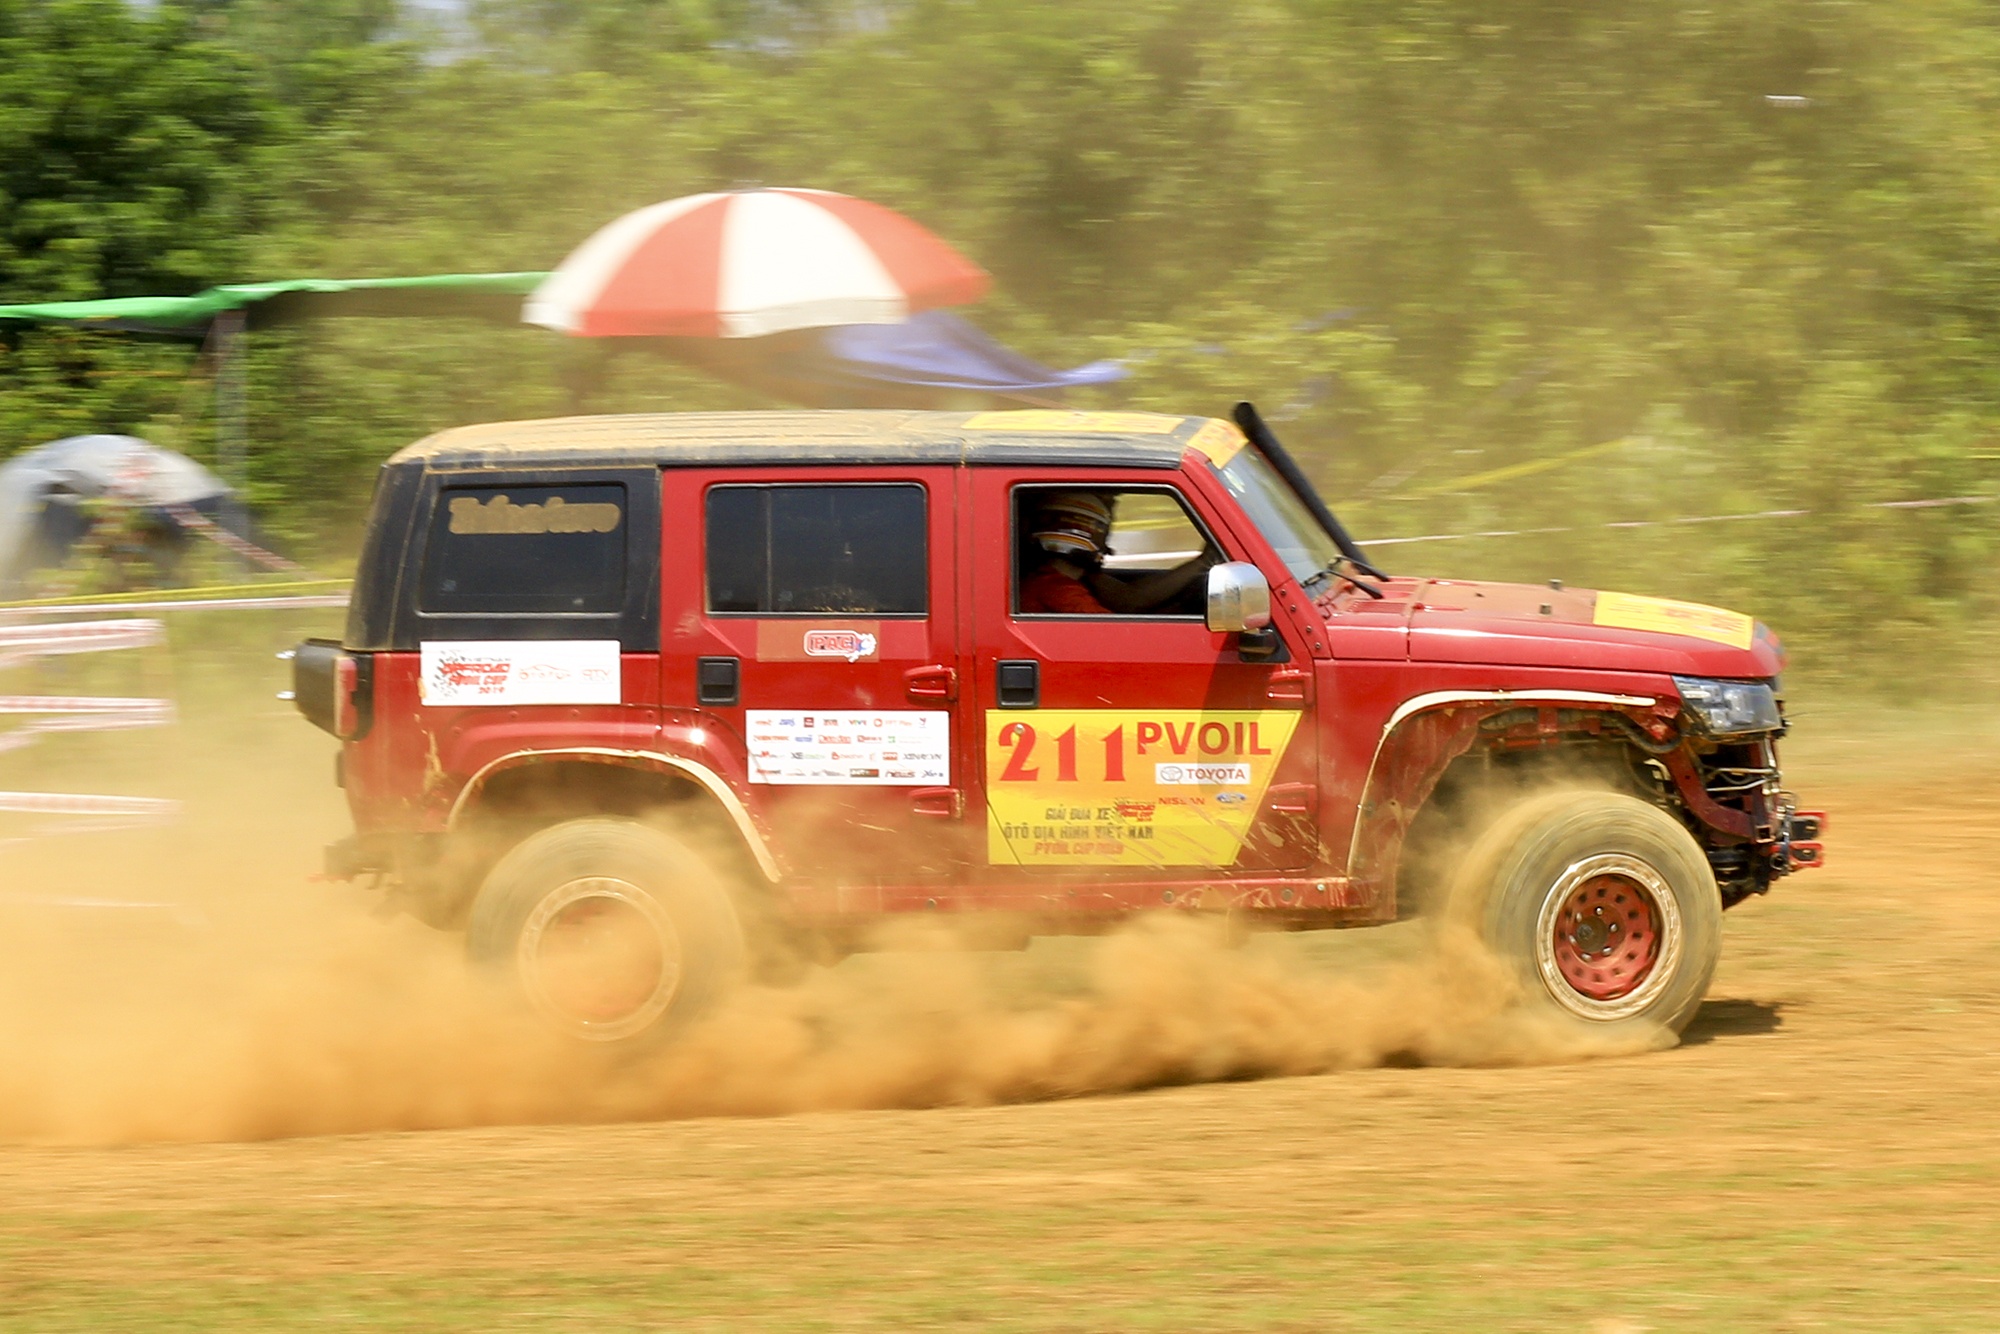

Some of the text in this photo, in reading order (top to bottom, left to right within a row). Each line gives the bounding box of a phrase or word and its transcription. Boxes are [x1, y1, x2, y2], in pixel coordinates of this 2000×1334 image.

[1136, 722, 1272, 755] PVOIL
[998, 722, 1127, 782] 211
[1186, 768, 1246, 779] TOYOTA
[1096, 807, 1111, 820] XE
